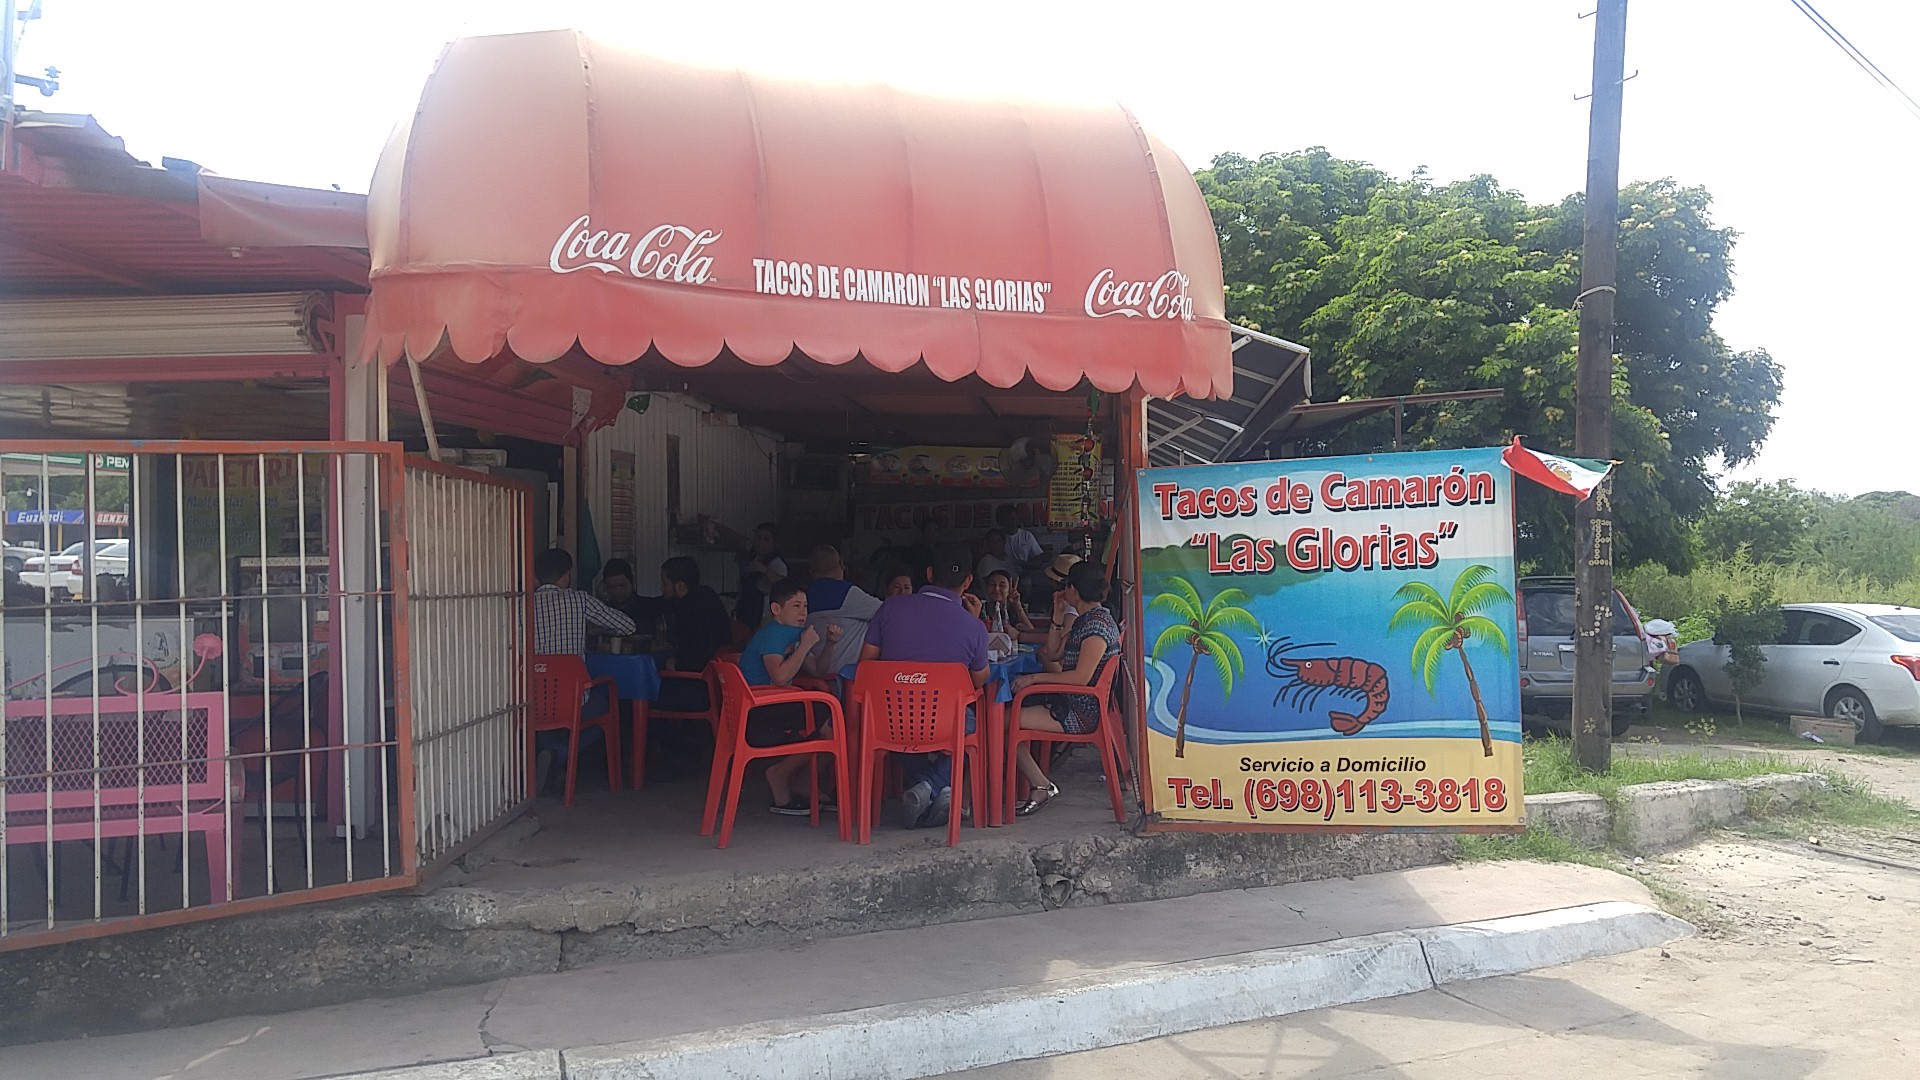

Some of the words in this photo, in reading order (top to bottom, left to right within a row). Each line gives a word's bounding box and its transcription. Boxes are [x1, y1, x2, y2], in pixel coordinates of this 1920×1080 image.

[752, 258, 813, 297] TACOS
[817, 264, 841, 300] DE
[844, 267, 930, 307] CAMARON
[932, 274, 971, 310] “LAS
[975, 277, 1051, 313] GLORIAS”
[183, 459, 309, 488] PALETRI
[1153, 482, 1259, 520] Tacos
[1265, 476, 1314, 514] de
[1320, 465, 1496, 510] Camarón
[955, 503, 992, 528] DE
[1189, 531, 1276, 575] “Las
[1285, 521, 1460, 573] Glorias”
[1239, 756, 1315, 773] Servicio
[1320, 761, 1331, 773] a
[1336, 756, 1427, 773] Domicilio
[1167, 776, 1234, 810] Tel.
[1243, 776, 1508, 822] (698)113-3818
